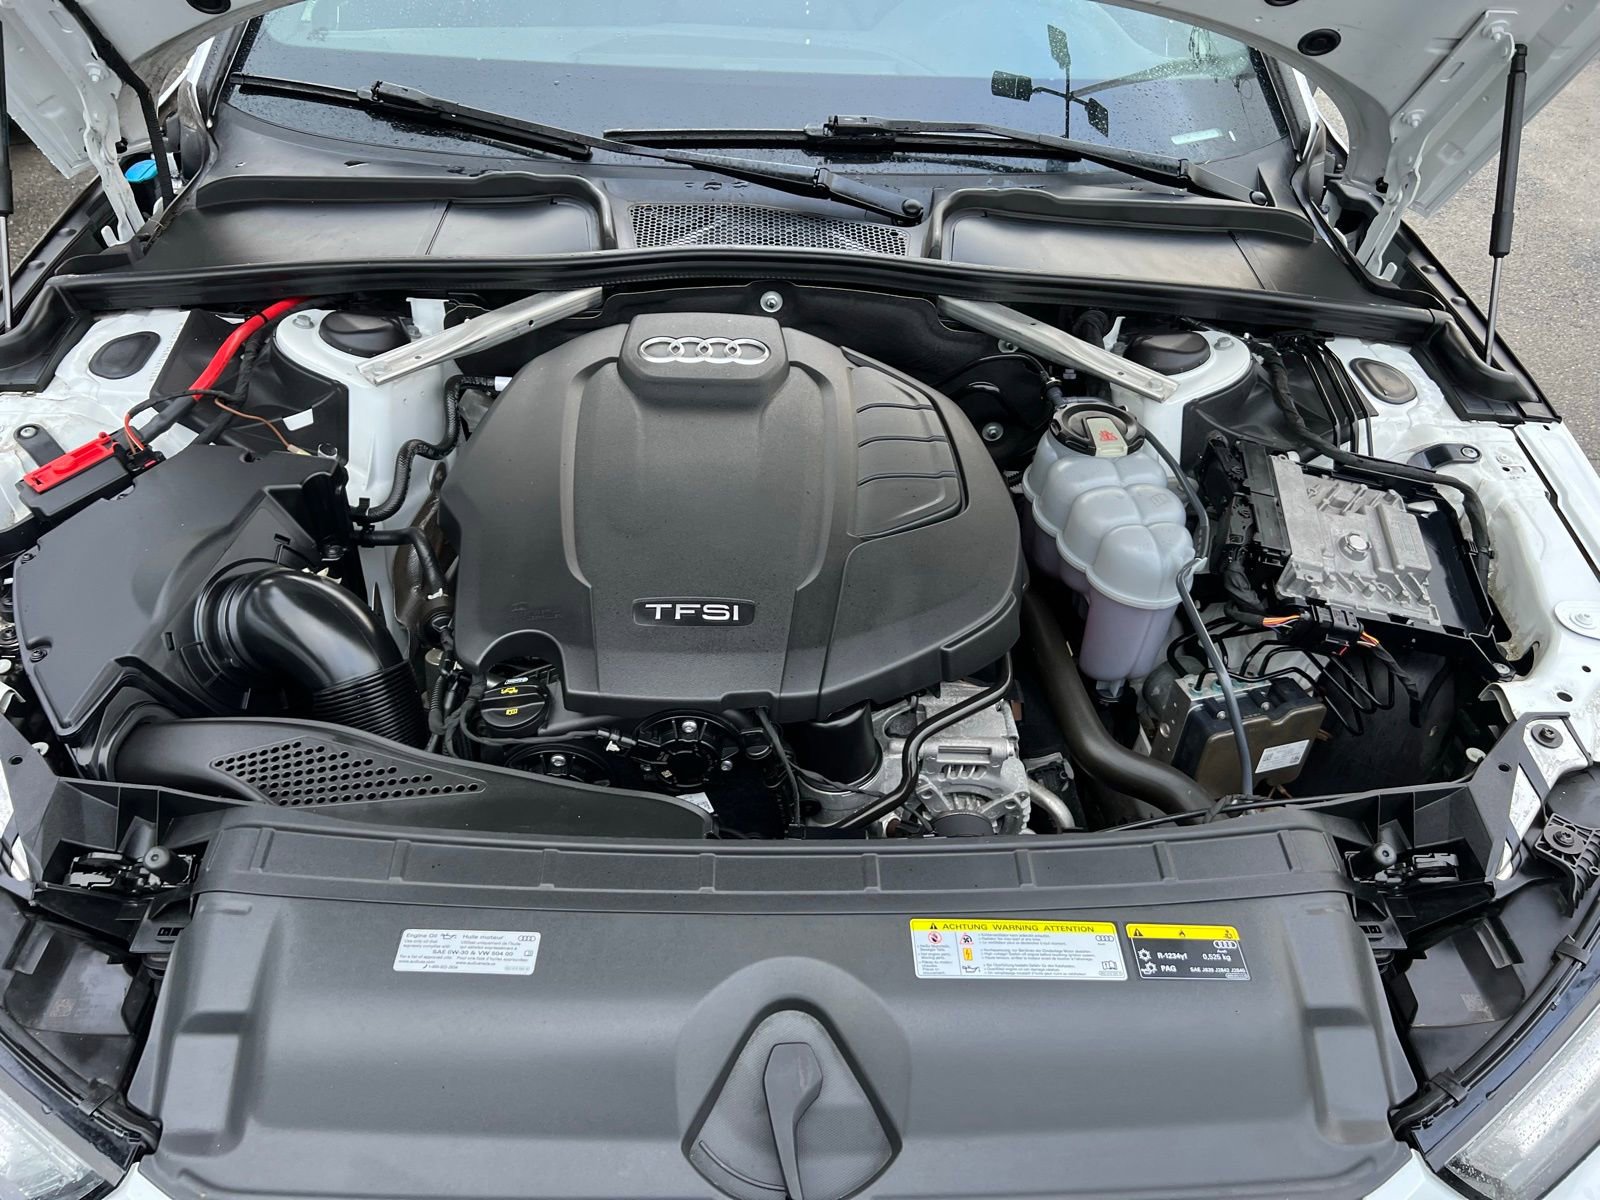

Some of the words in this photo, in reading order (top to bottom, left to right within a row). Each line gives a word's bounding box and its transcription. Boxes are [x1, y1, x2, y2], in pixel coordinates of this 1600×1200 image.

[645, 603, 739, 621] TFSI
[942, 923, 988, 931] ACHTUNG
[992, 924, 1039, 932] WARNING
[1043, 925, 1095, 933] ATTENTION
[1222, 954, 1232, 962] kg
[1160, 965, 1177, 973] PAG
